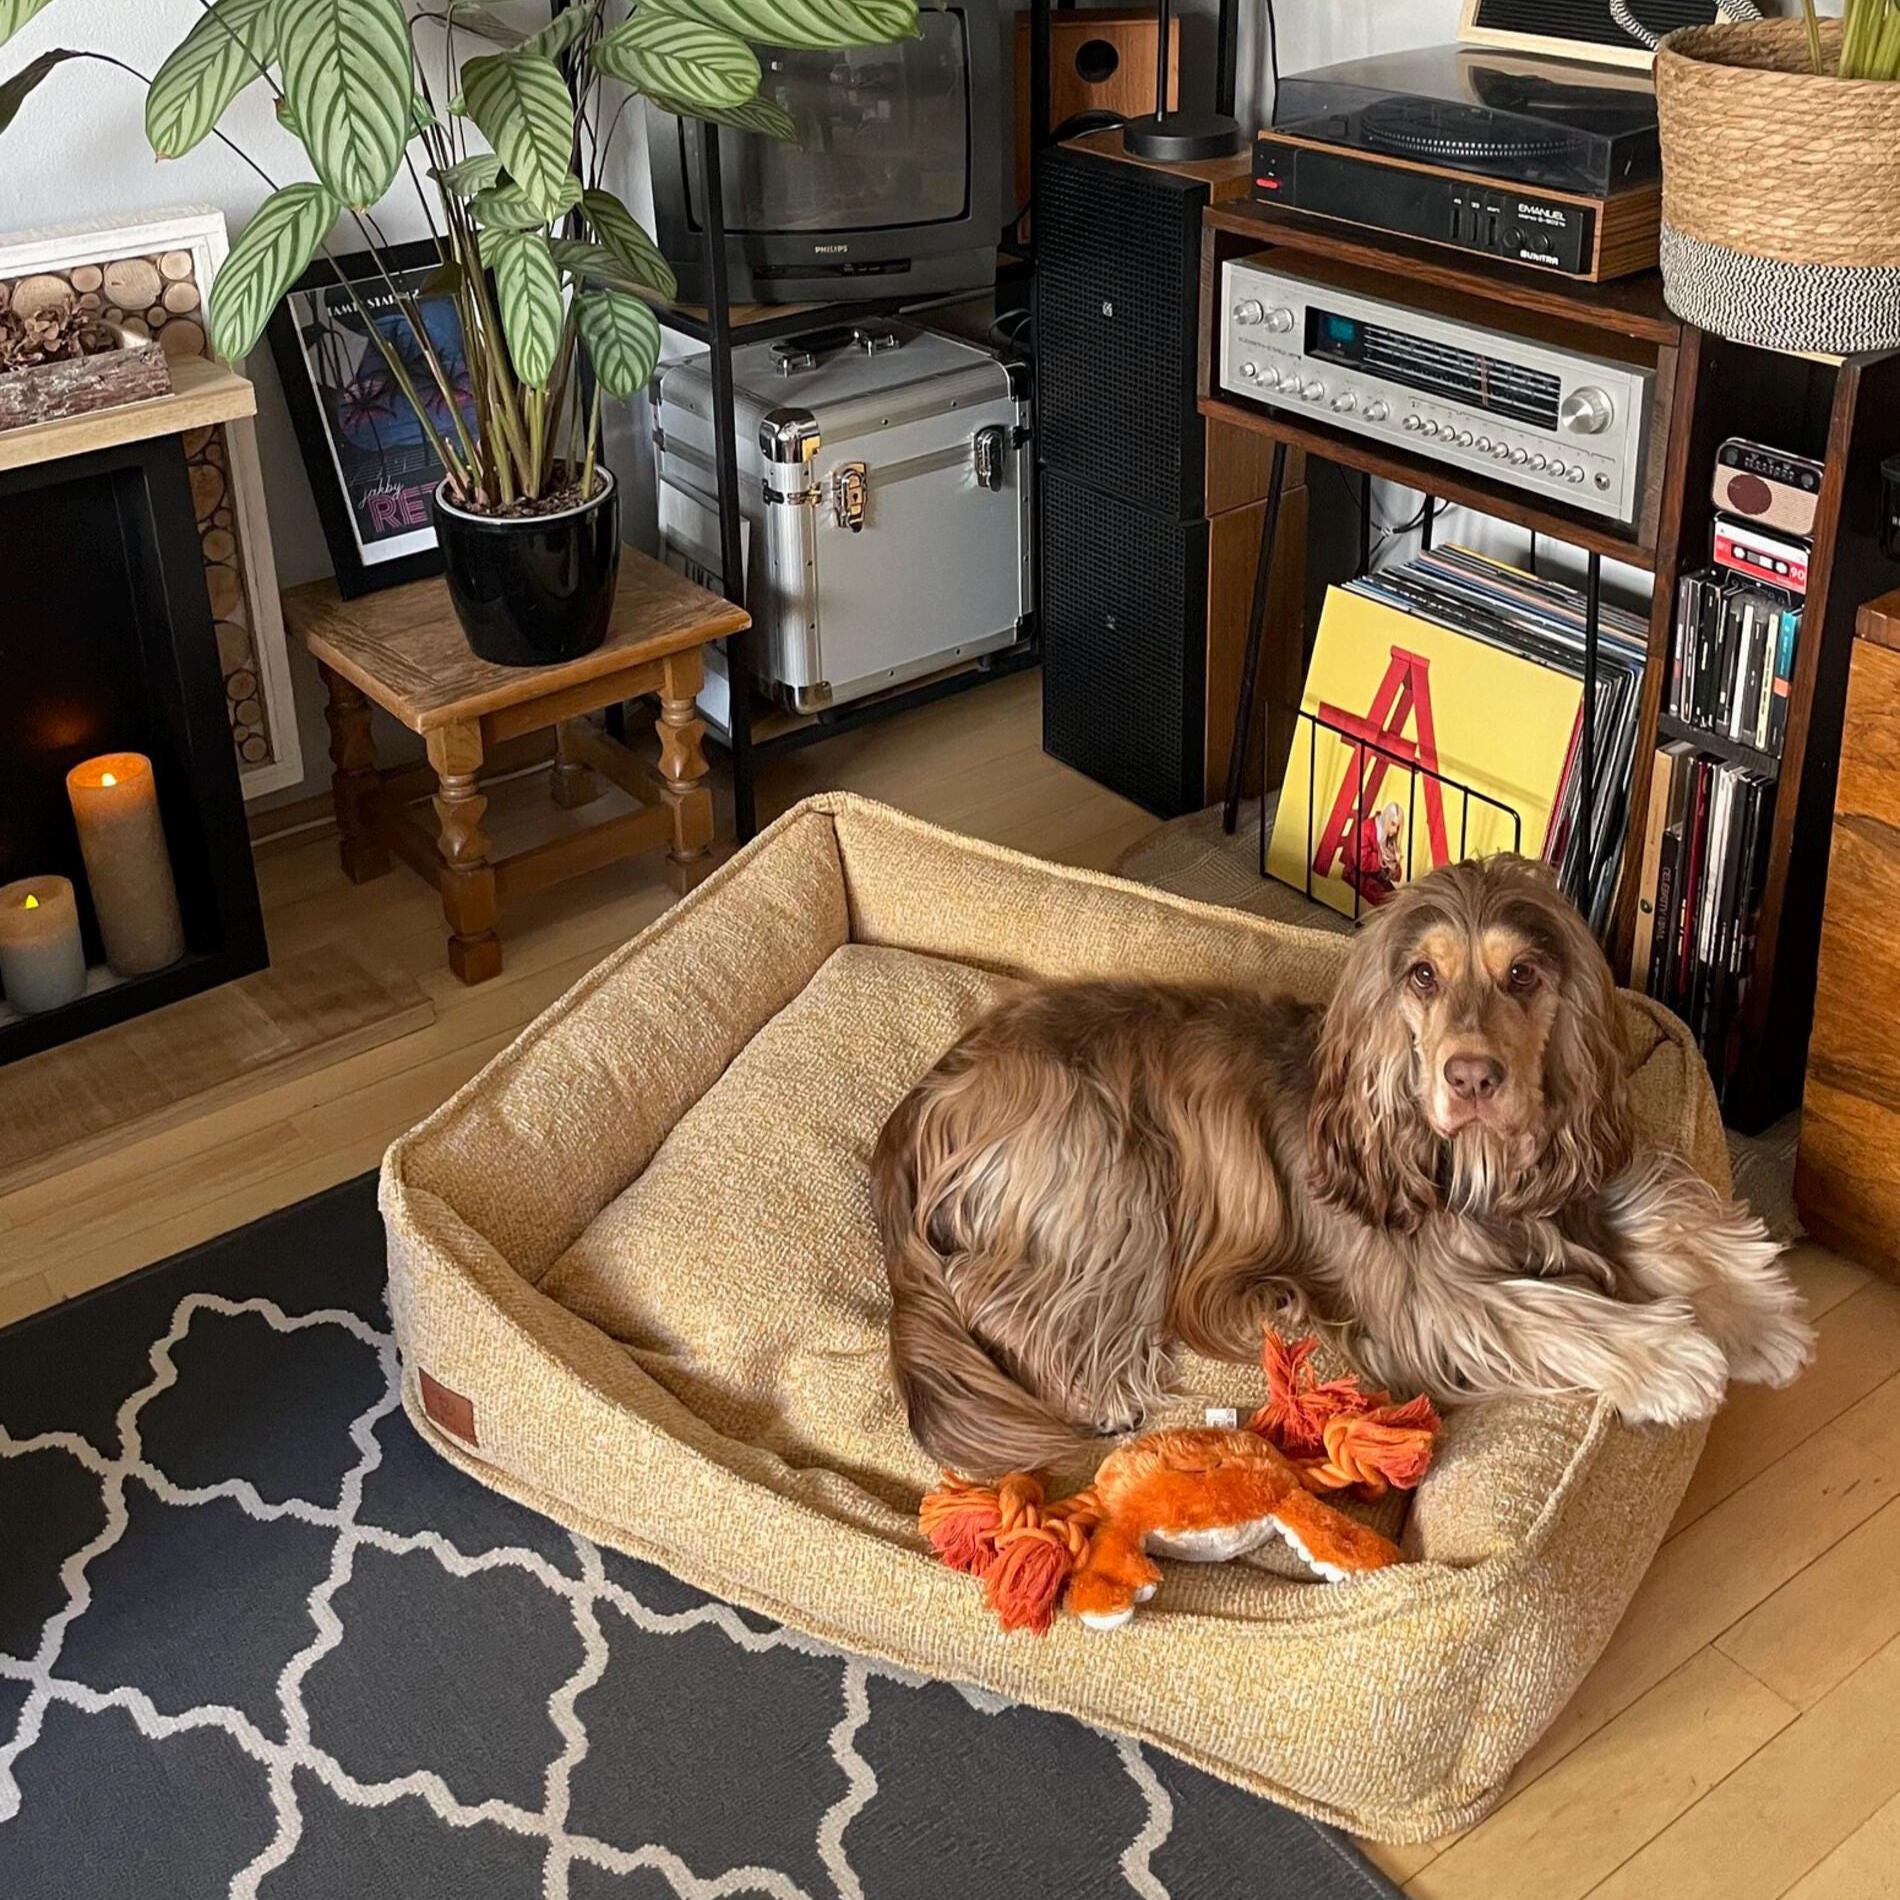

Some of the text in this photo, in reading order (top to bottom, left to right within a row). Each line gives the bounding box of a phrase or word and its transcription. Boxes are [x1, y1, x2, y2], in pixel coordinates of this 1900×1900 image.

[1518, 203, 1567, 222] EMANUEL
[815, 244, 848, 254] PHILIPS
[1790, 566, 1804, 581] 90
